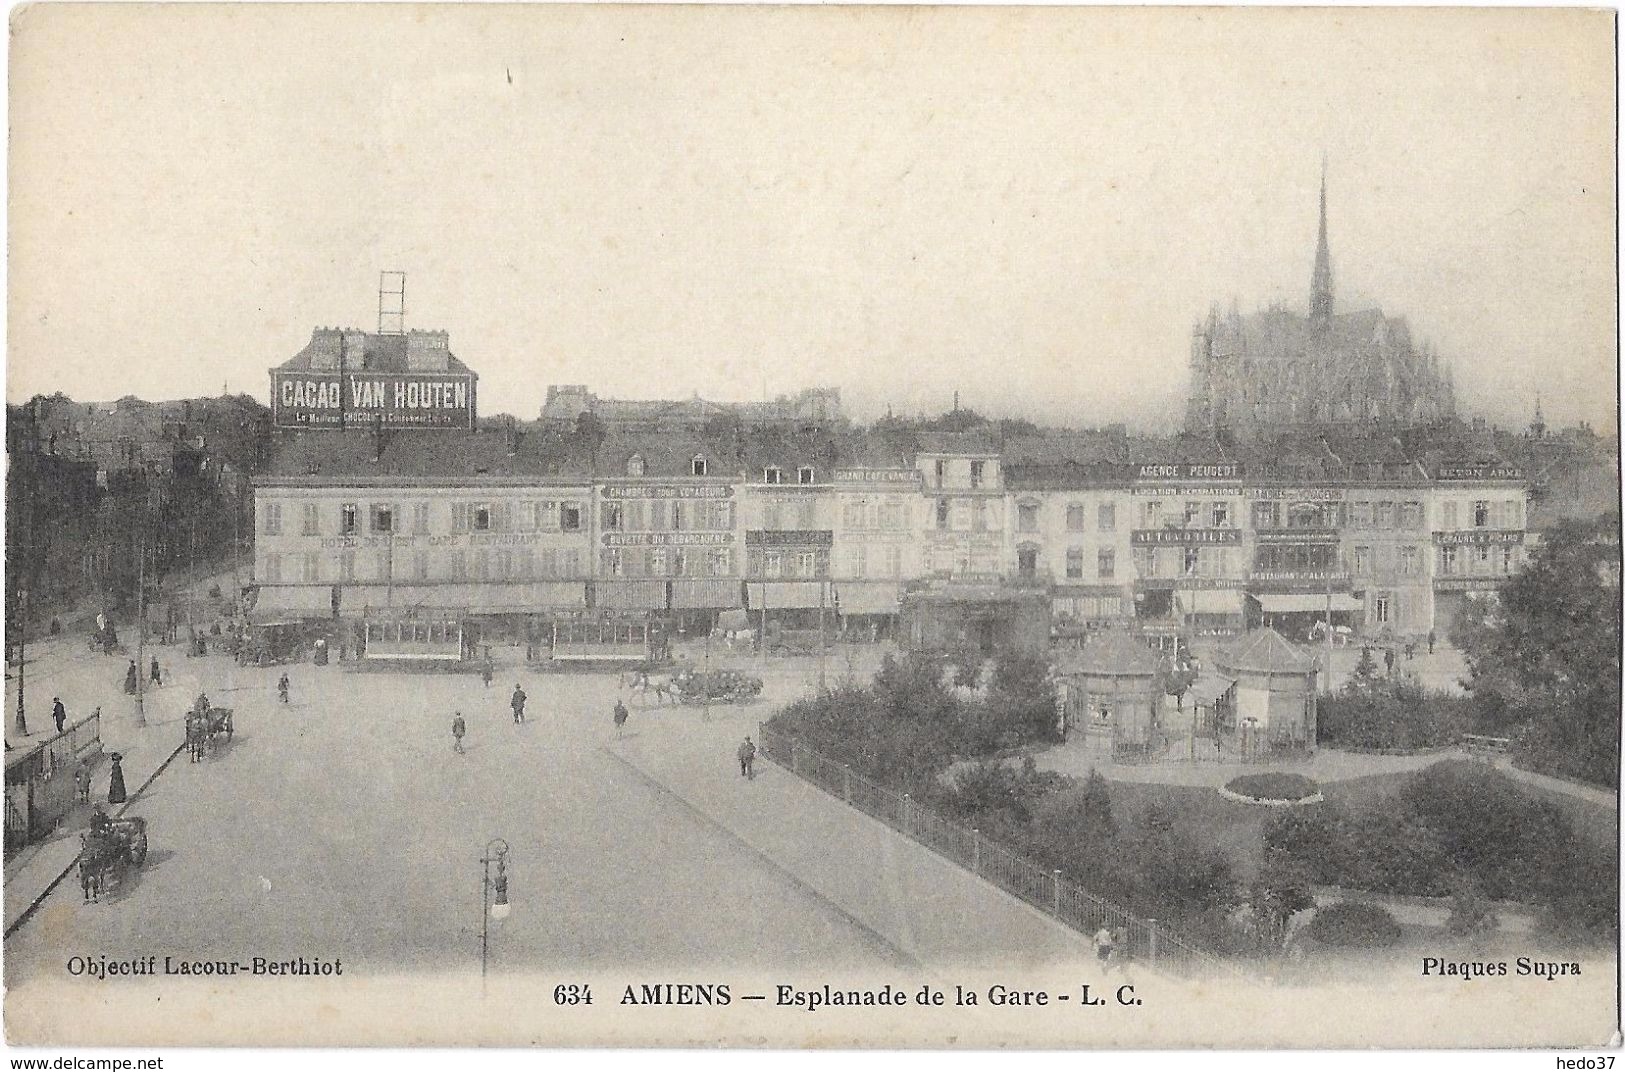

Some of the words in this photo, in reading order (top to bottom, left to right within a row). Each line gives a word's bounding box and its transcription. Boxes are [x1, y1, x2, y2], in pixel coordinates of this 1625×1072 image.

[282, 380, 340, 409] CACAO
[350, 375, 385, 408] VAN
[395, 382, 466, 409] HOUTEN
[1140, 465, 1179, 477] AGENCE
[1190, 465, 1237, 477] PEUGEOT
[680, 487, 726, 497] VOYAGEURS
[610, 534, 647, 544] BUVETTE
[1138, 532, 1236, 543] AUTOMOBILES
